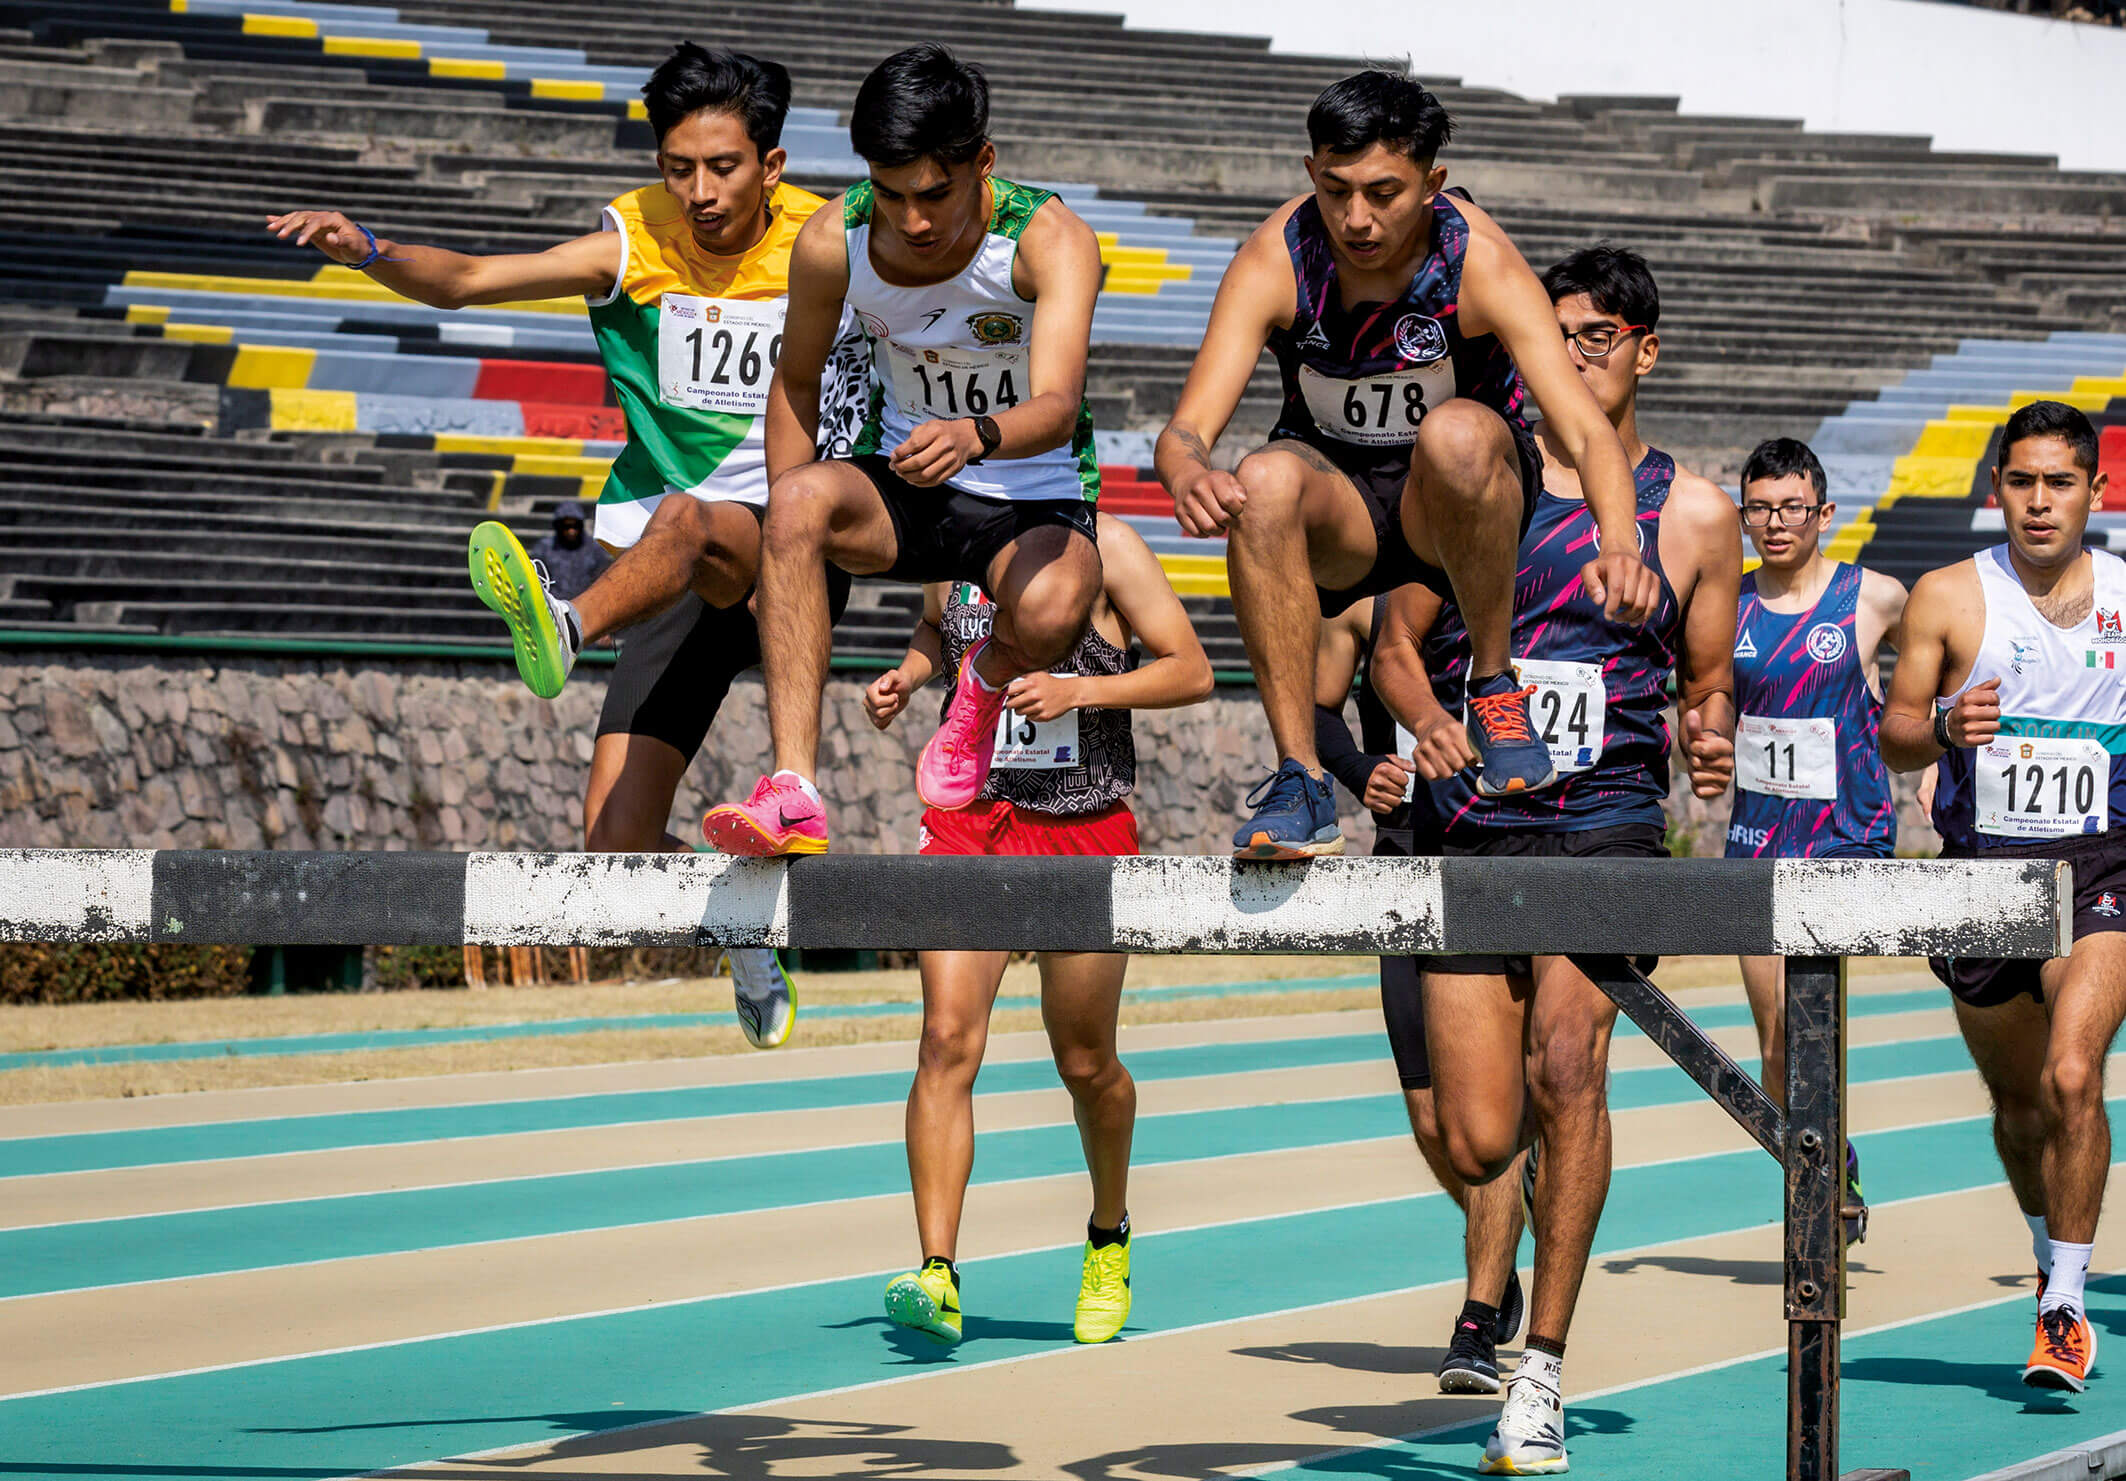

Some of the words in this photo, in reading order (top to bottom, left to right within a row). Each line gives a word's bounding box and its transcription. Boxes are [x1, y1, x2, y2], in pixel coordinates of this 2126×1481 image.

[686, 386, 740, 398] Campeonato
[715, 399, 756, 408] Atletismo
[913, 364, 1018, 414] 1164
[1343, 382, 1428, 427] 678
[961, 618, 993, 639] LYC
[1541, 690, 1589, 745] 24
[1764, 741, 1795, 781] 11
[2001, 764, 2094, 814] 1210
[2003, 815, 2050, 825] Campeonato
[2053, 817, 2079, 825] Estatal
